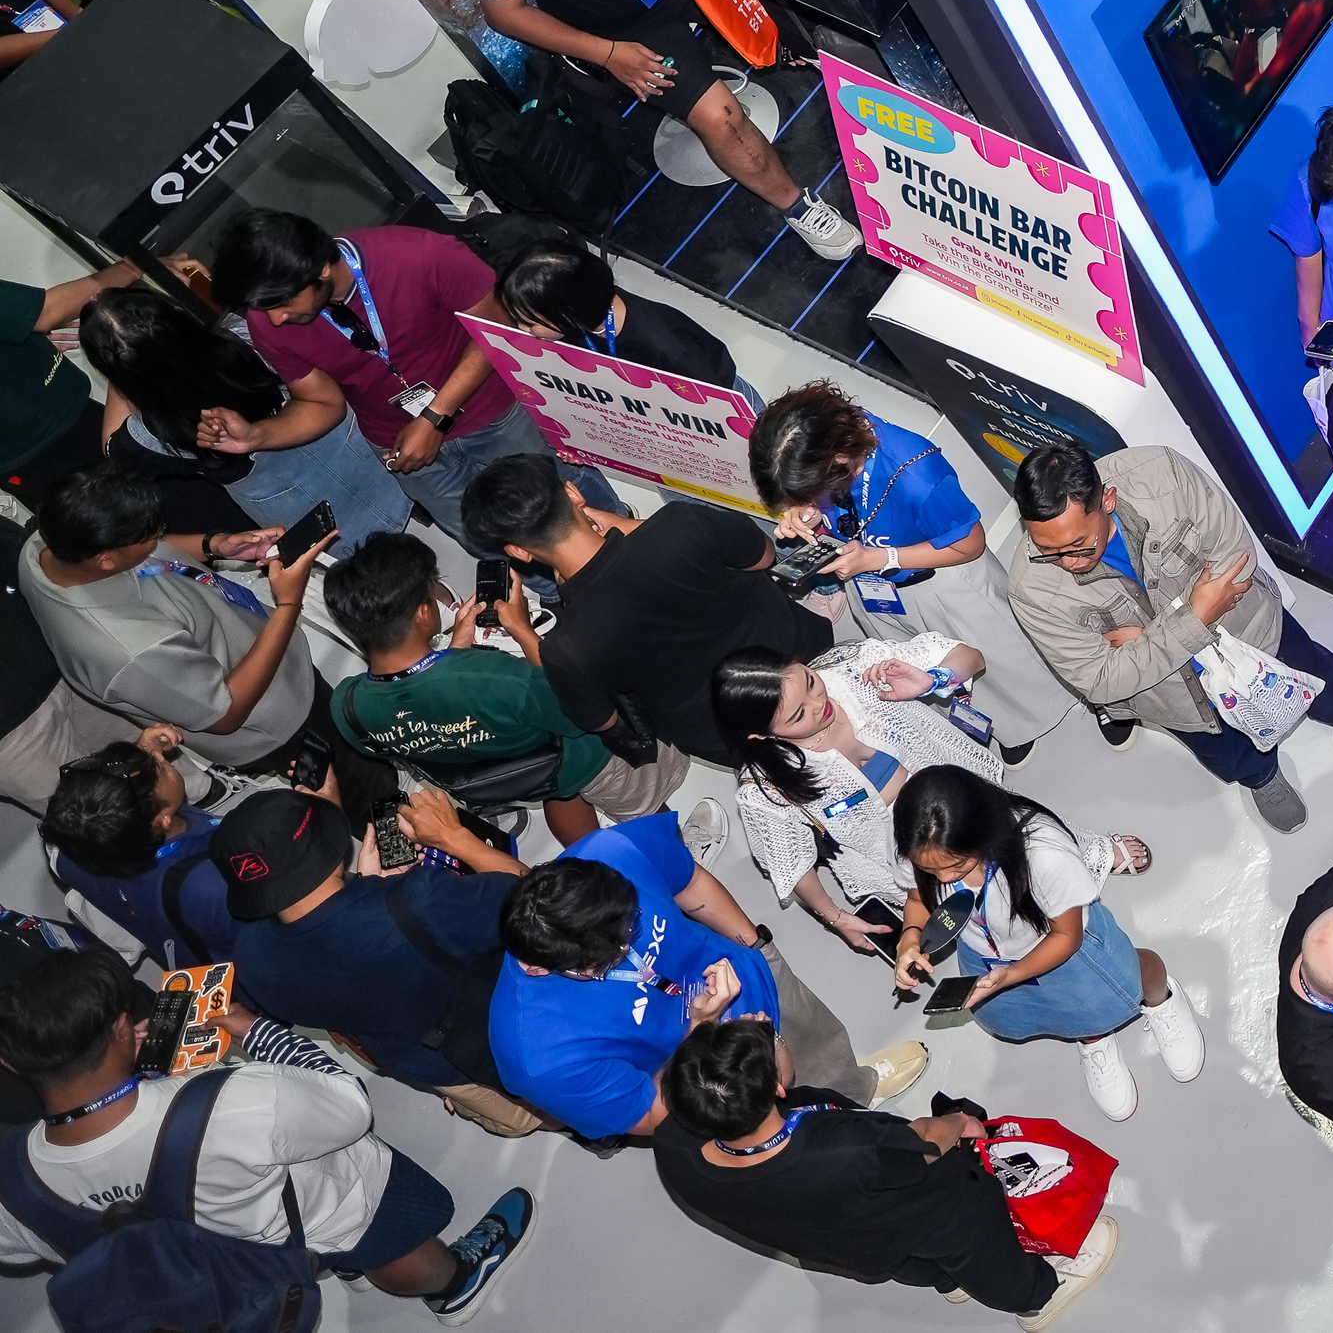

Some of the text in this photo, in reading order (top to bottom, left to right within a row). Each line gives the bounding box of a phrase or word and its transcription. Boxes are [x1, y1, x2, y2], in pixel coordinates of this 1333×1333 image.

[182, 103, 255, 174] triv
[857, 96, 935, 144] FREE
[883, 145, 1072, 255] BITCOIN BAR
[901, 183, 1068, 280] CHALLENGE
[900, 252, 920, 269] triv
[922, 232, 1060, 306] Take the Bitcoin Bar and
[937, 251, 956, 266] Win
[960, 261, 982, 279] the
[984, 274, 1019, 298] Grand
[1022, 293, 1054, 314] Prize!
[951, 236, 1026, 278] Grab & Win!
[534, 370, 613, 405] SNAP
[660, 406, 728, 440] WIN
[970, 391, 1074, 442] 1000+ Coins
[977, 371, 1047, 412] triv
